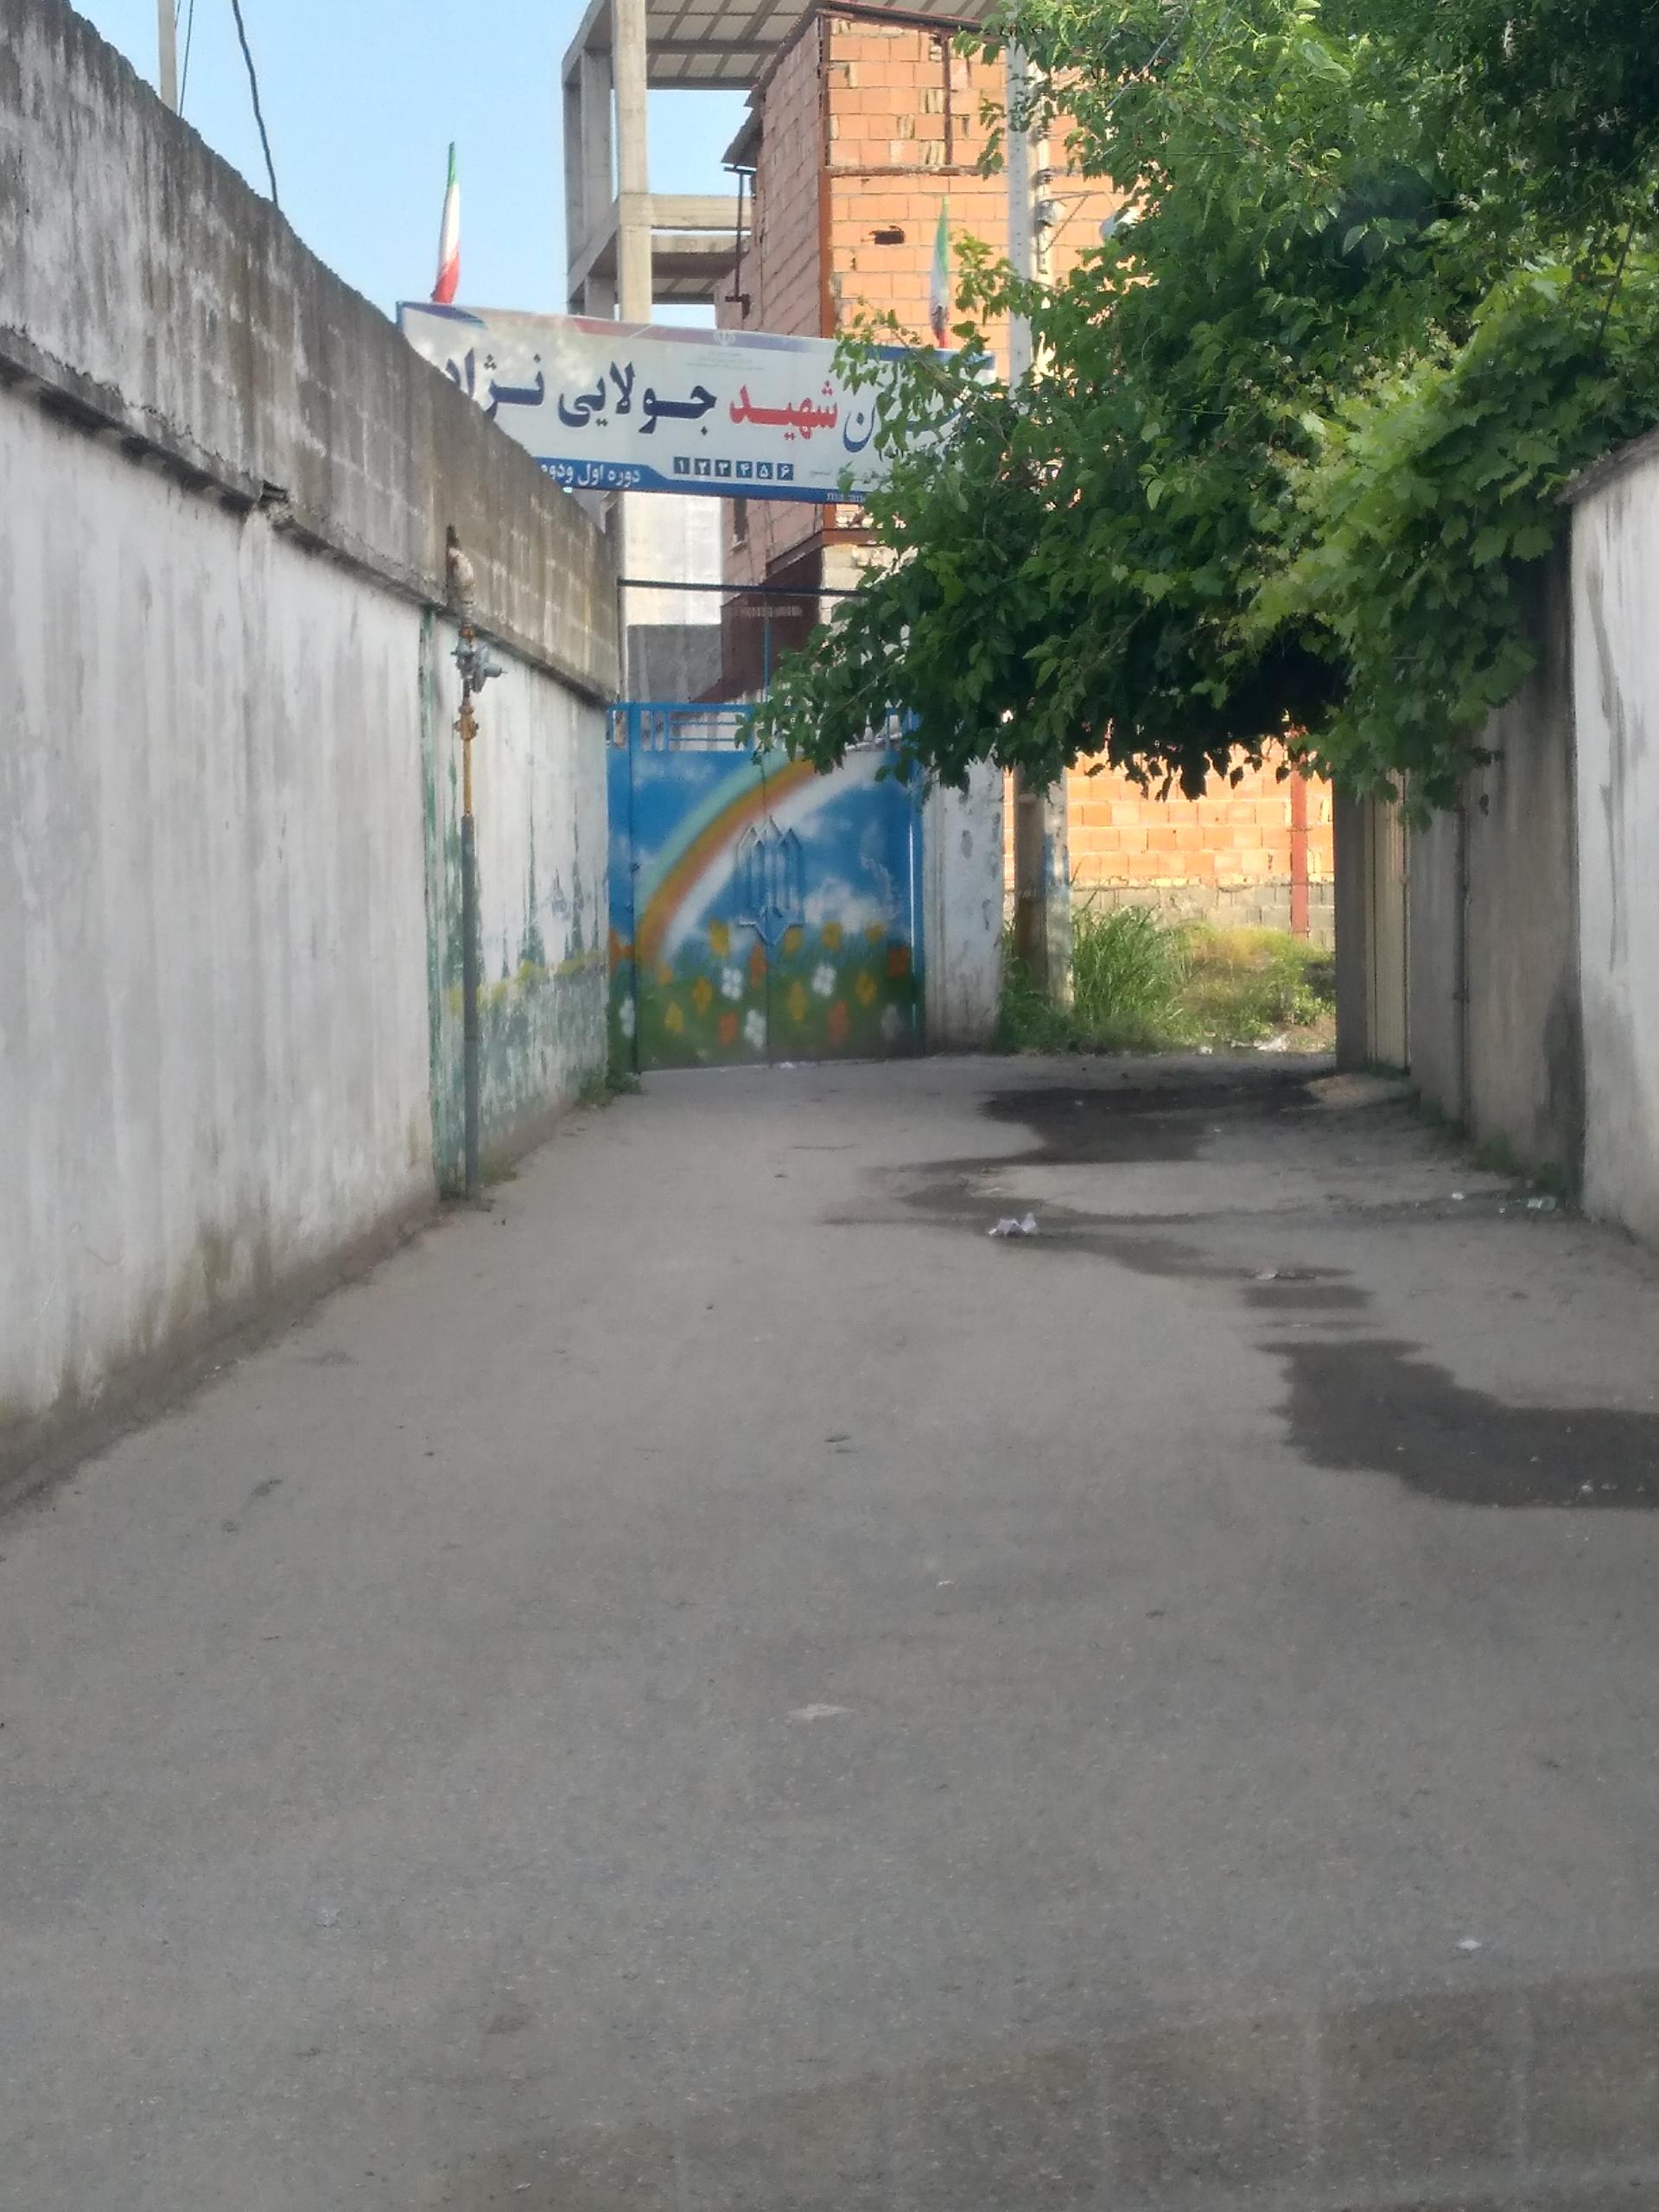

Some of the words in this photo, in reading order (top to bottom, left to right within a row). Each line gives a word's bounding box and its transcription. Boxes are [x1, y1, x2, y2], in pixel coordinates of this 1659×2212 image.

[557, 360, 718, 436] جولایی
[729, 379, 838, 440] شهید
[577, 462, 604, 486] اول
[608, 469, 640, 487] دوره
